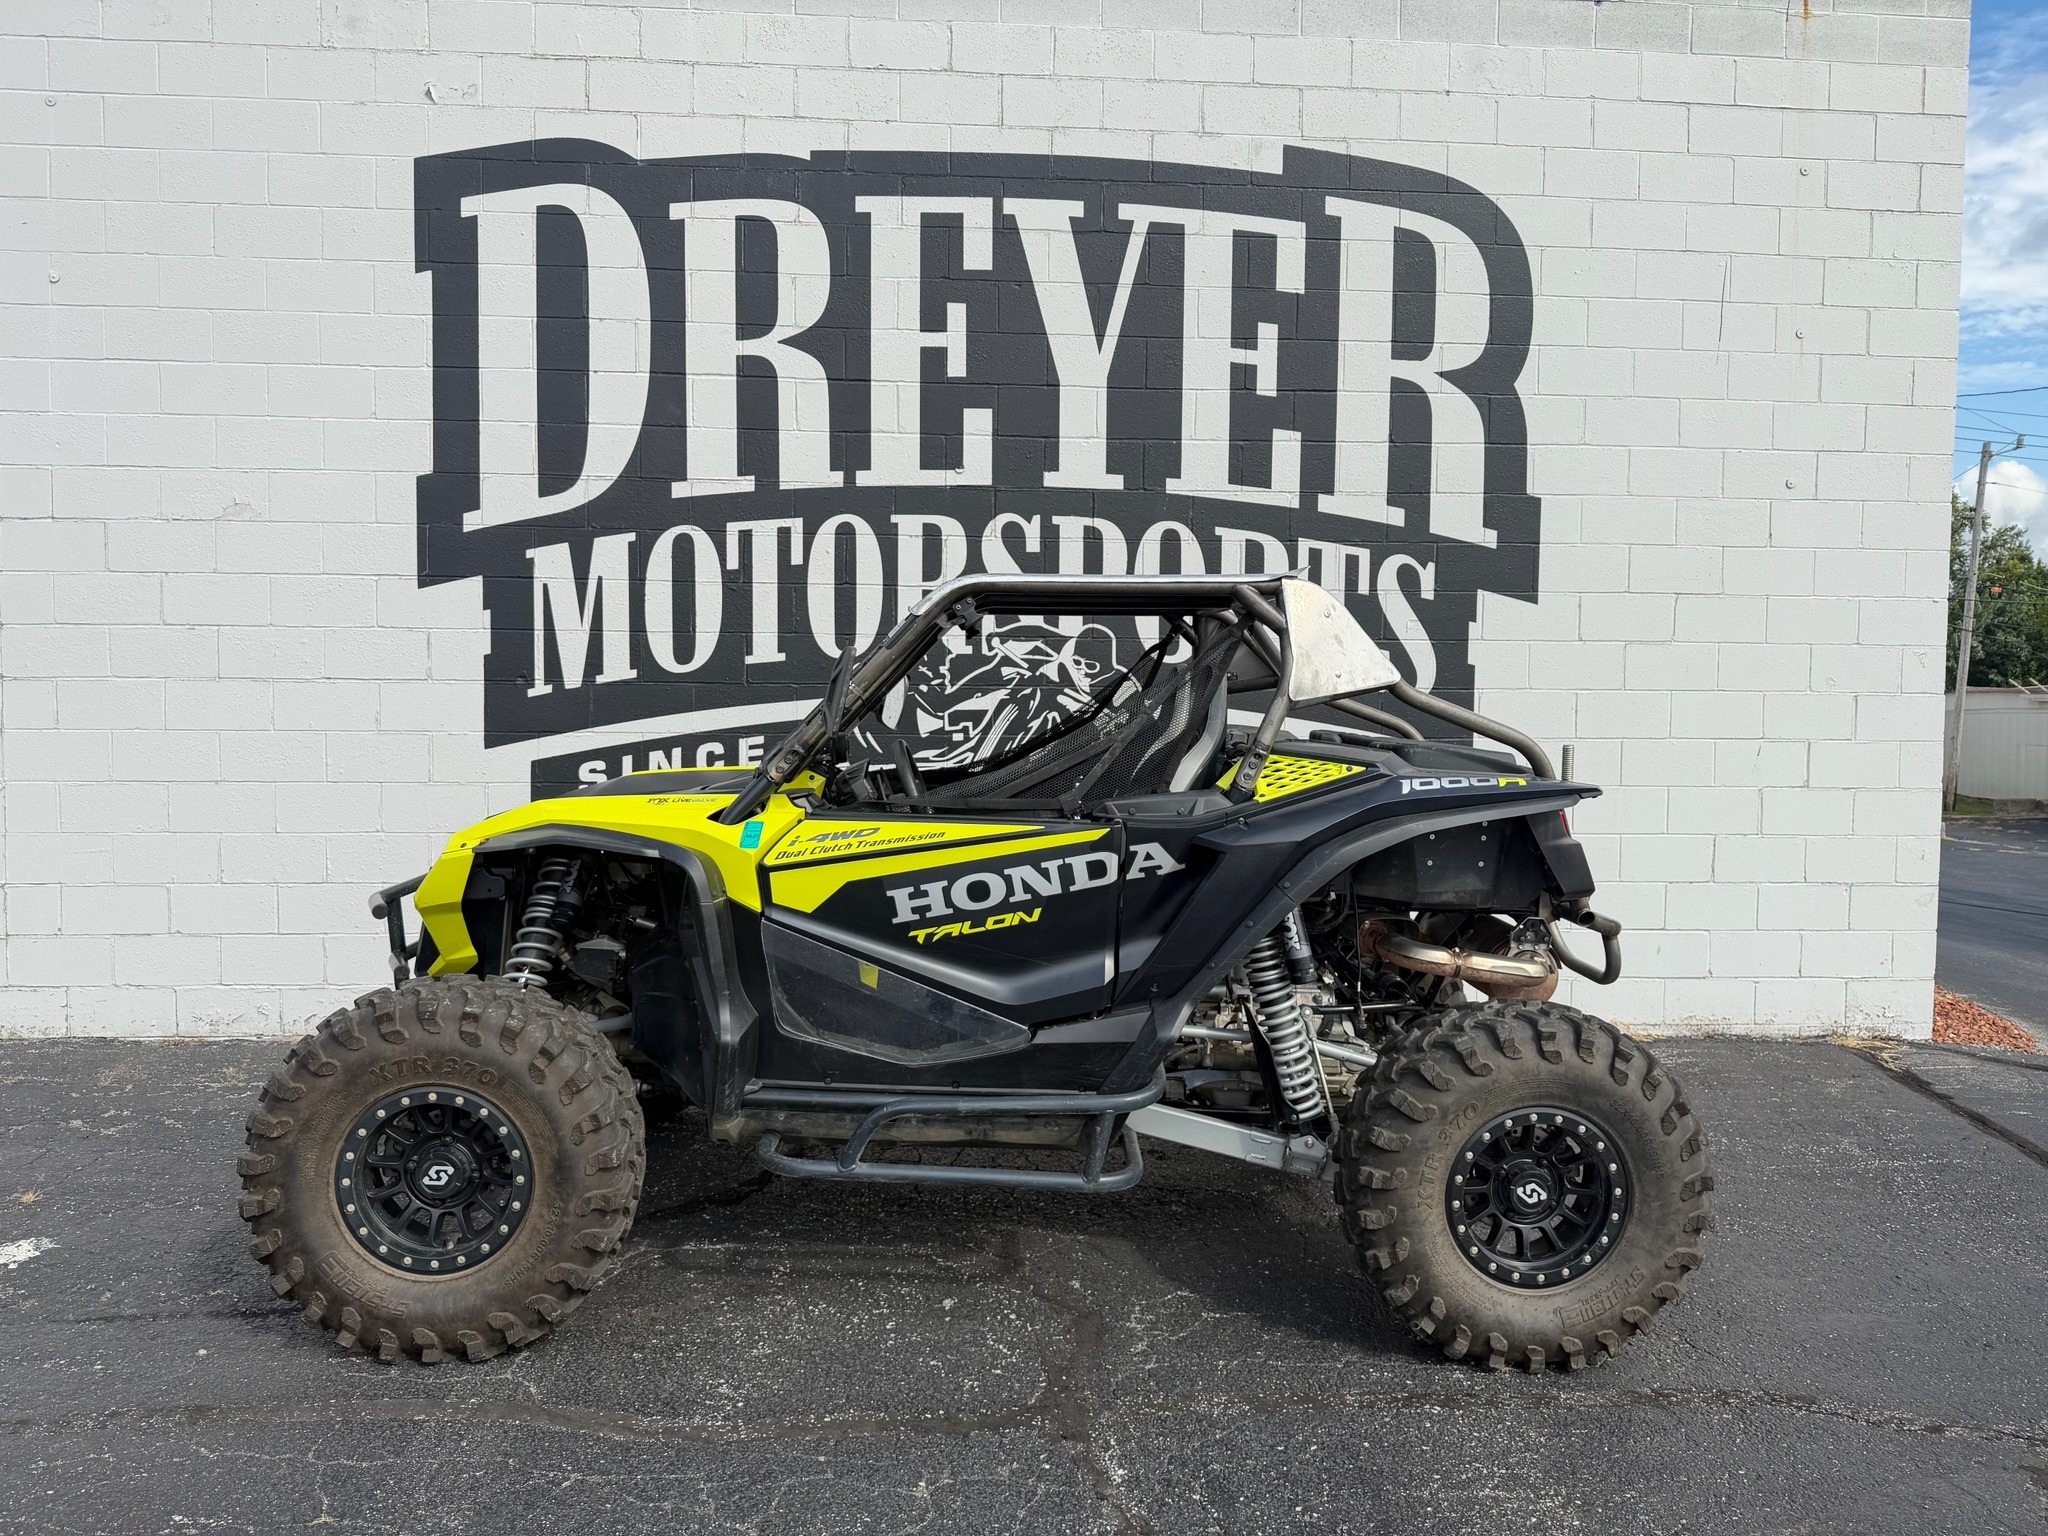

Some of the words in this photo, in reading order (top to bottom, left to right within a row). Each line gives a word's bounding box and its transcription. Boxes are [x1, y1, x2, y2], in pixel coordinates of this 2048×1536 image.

[460, 183, 1497, 549] DREYER
[578, 735, 765, 790] SINCE
[774, 848, 808, 861] Dual
[810, 838, 852, 855] Clutch
[855, 831, 946, 849] Transmission
[787, 827, 881, 847] i-4WD
[886, 842, 1186, 924] HONDA
[908, 907, 1043, 945] TALON
[368, 1055, 433, 1087] XTR
[441, 1056, 498, 1086] 370
[1417, 1151, 1444, 1211] XTR
[1438, 1100, 1481, 1147] 370
